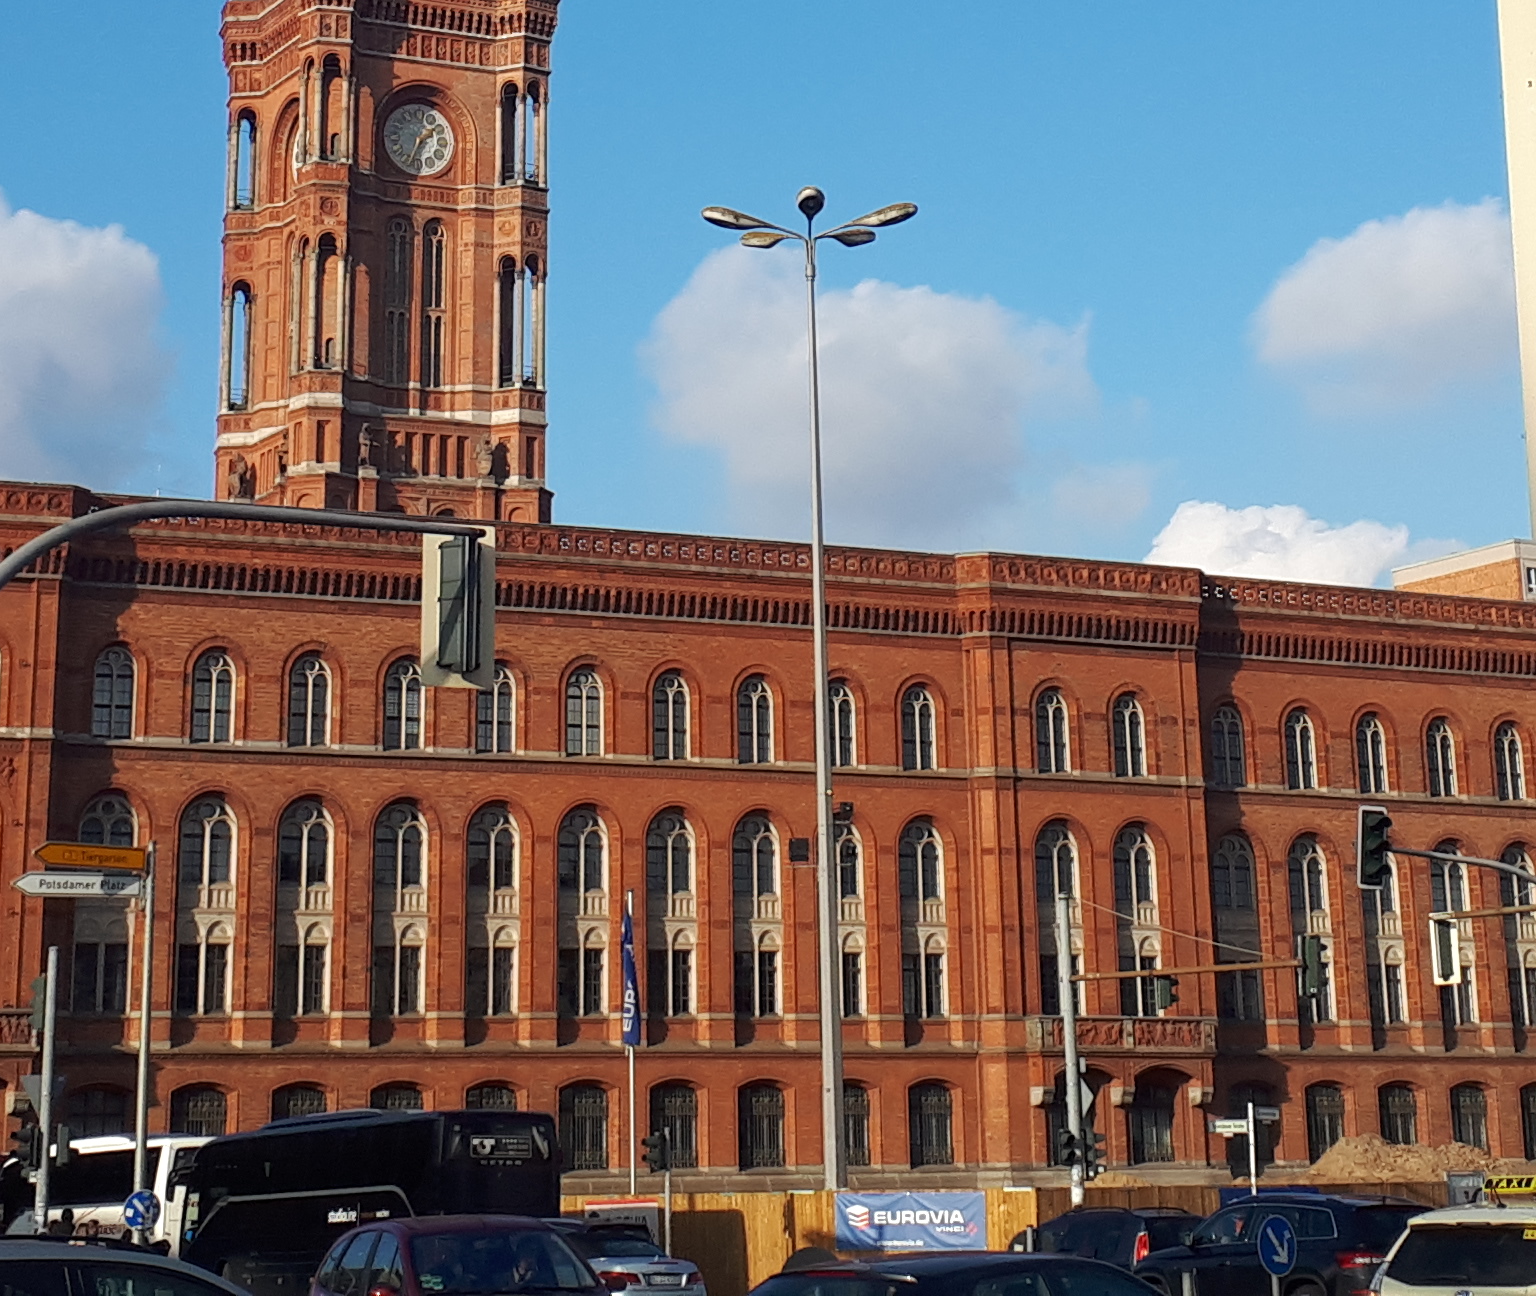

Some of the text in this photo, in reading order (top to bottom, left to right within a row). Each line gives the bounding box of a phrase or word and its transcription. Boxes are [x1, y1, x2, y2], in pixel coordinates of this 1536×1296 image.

[39, 879, 126, 890] Potsdamer Platz
[1492, 1178, 1527, 1189] TAXI
[874, 1210, 964, 1224] EUROVIA
